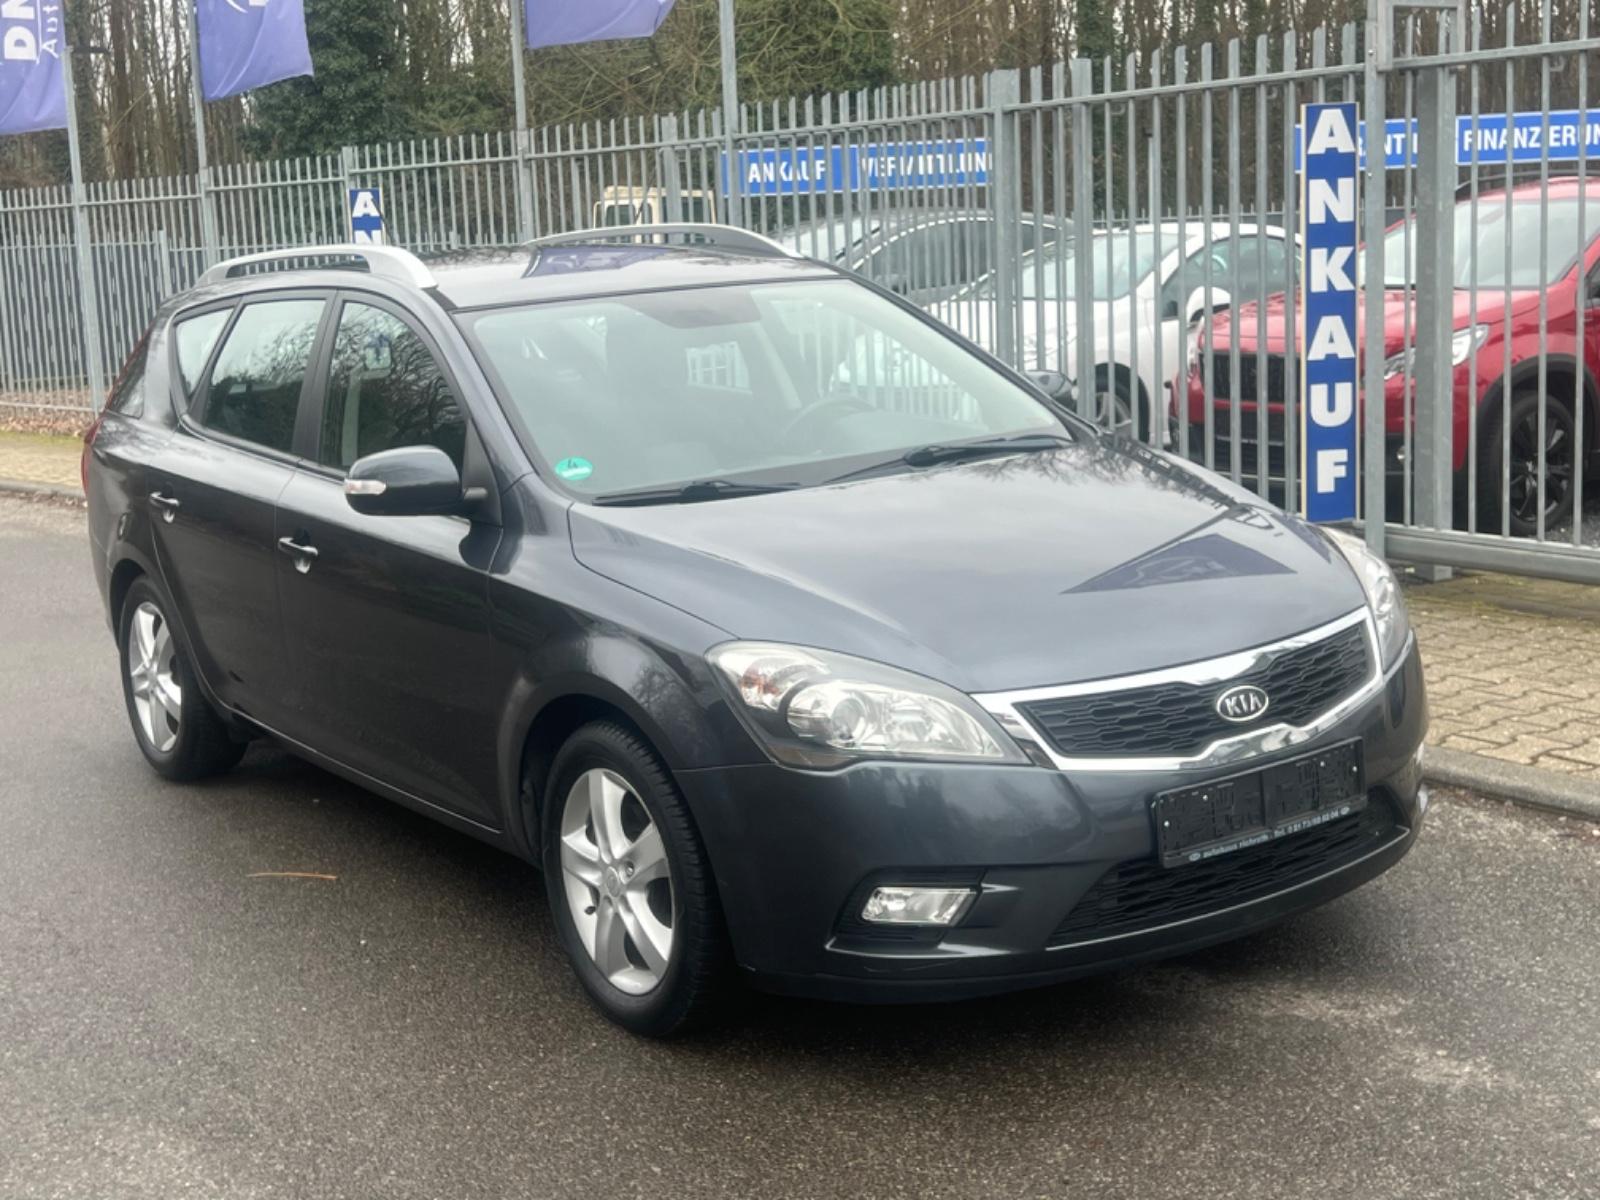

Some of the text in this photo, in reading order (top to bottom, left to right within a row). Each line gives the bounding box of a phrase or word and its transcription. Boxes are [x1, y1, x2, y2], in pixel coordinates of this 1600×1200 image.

[1463, 123, 1600, 152] FINANZERUN
[1307, 109, 1355, 493] ANKAUF
[1225, 692, 1262, 716] KIA
